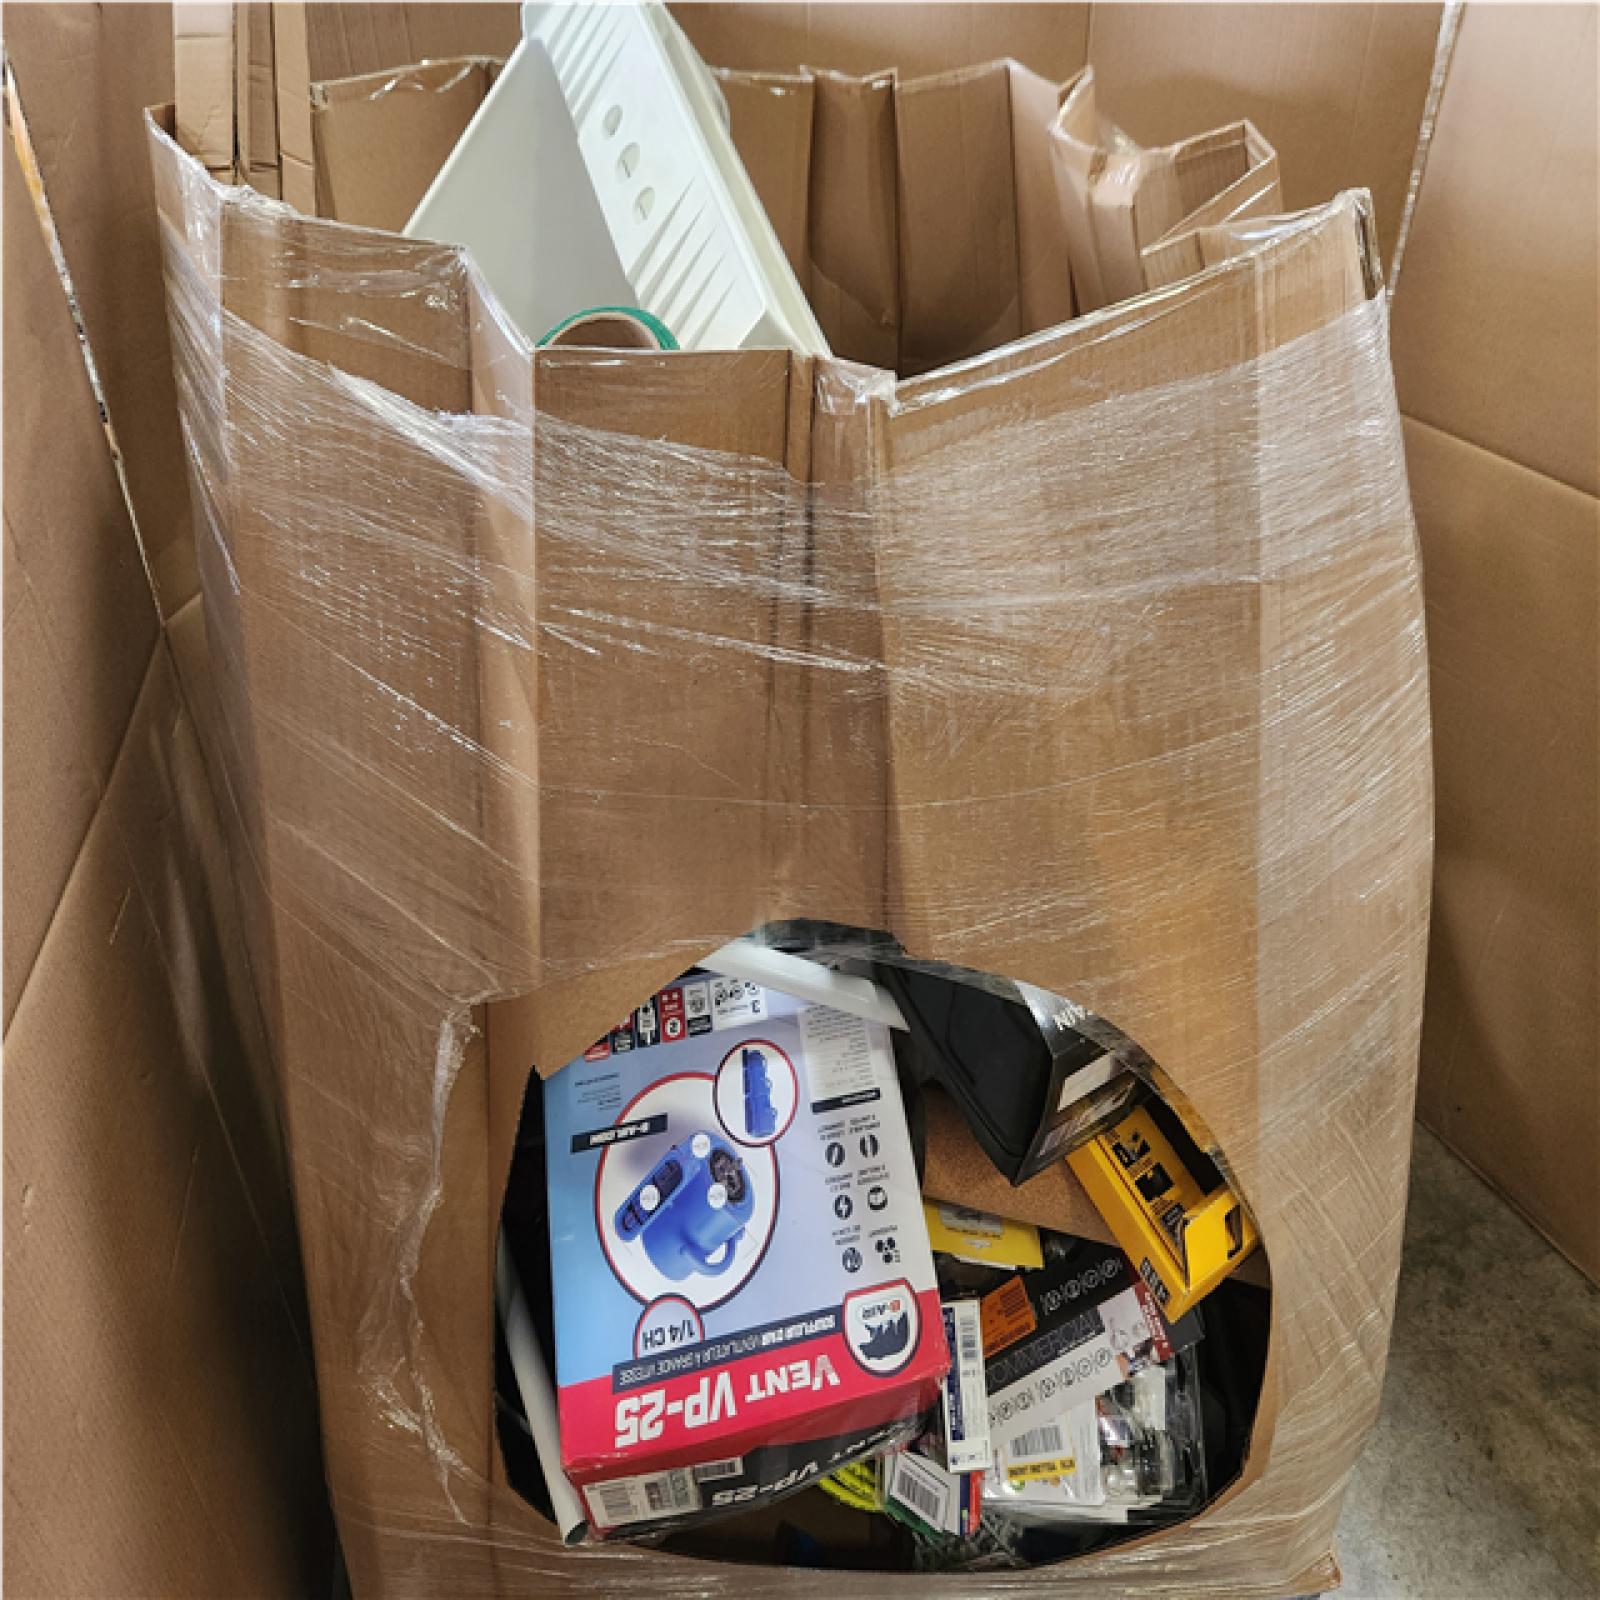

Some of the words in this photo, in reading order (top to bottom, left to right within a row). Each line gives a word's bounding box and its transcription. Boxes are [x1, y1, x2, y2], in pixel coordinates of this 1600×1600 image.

[643, 1331, 666, 1350] CH
[669, 1319, 695, 1344] 1/4
[745, 1354, 840, 1404] VENT
[615, 1371, 738, 1448] VP-25
